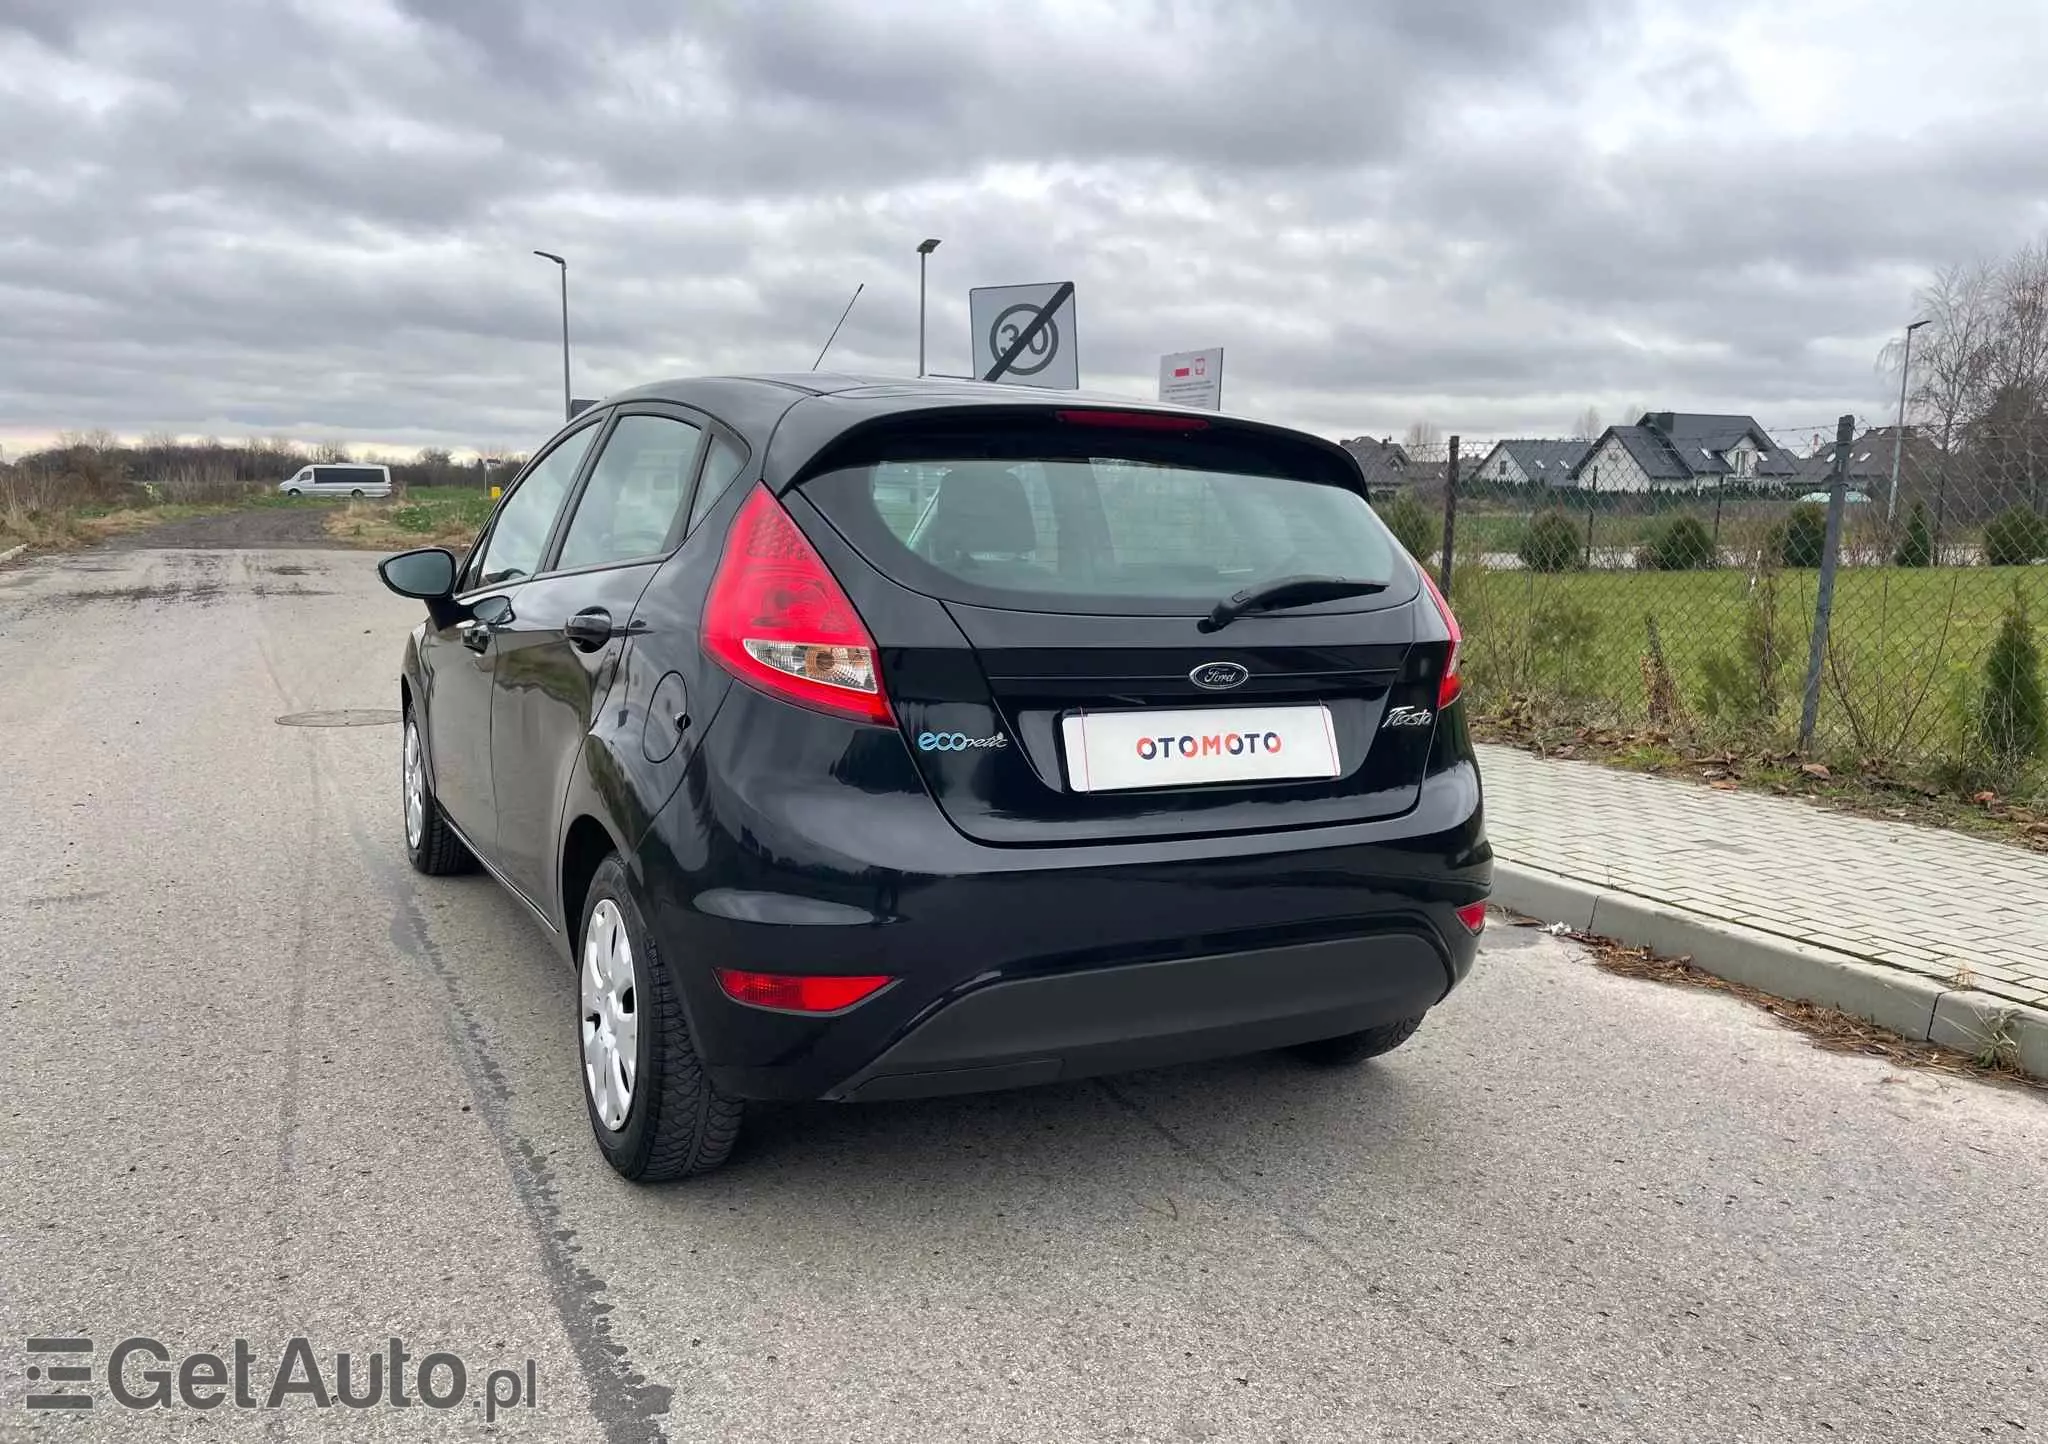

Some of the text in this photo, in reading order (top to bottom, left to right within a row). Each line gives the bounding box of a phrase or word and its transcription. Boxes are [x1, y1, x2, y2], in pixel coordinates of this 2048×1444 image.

[1000, 323, 1049, 356] 30
[1204, 667, 1236, 682] Ford
[1382, 705, 1432, 728] Fiesta
[1136, 732, 1282, 760] OTOMOTO
